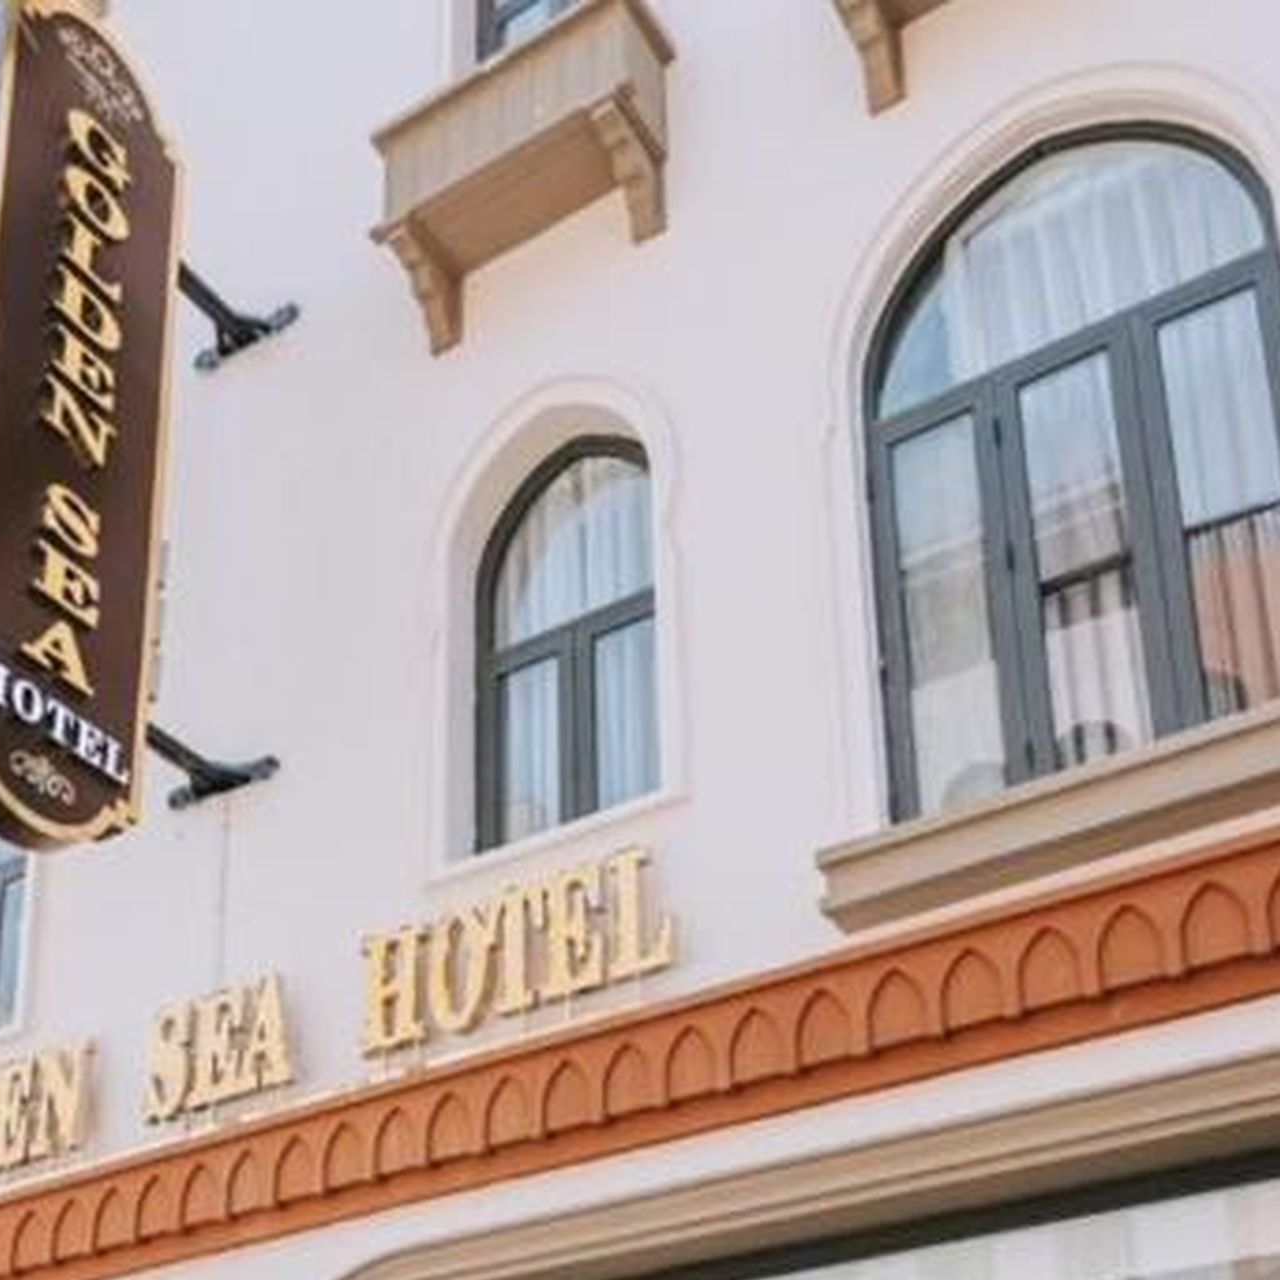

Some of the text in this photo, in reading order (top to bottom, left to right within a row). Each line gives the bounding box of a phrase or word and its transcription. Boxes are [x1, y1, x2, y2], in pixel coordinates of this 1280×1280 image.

[22, 108, 131, 697] GOLDEN SEA
[145, 972, 295, 1123] SEA
[362, 848, 675, 1057] HOTEL
